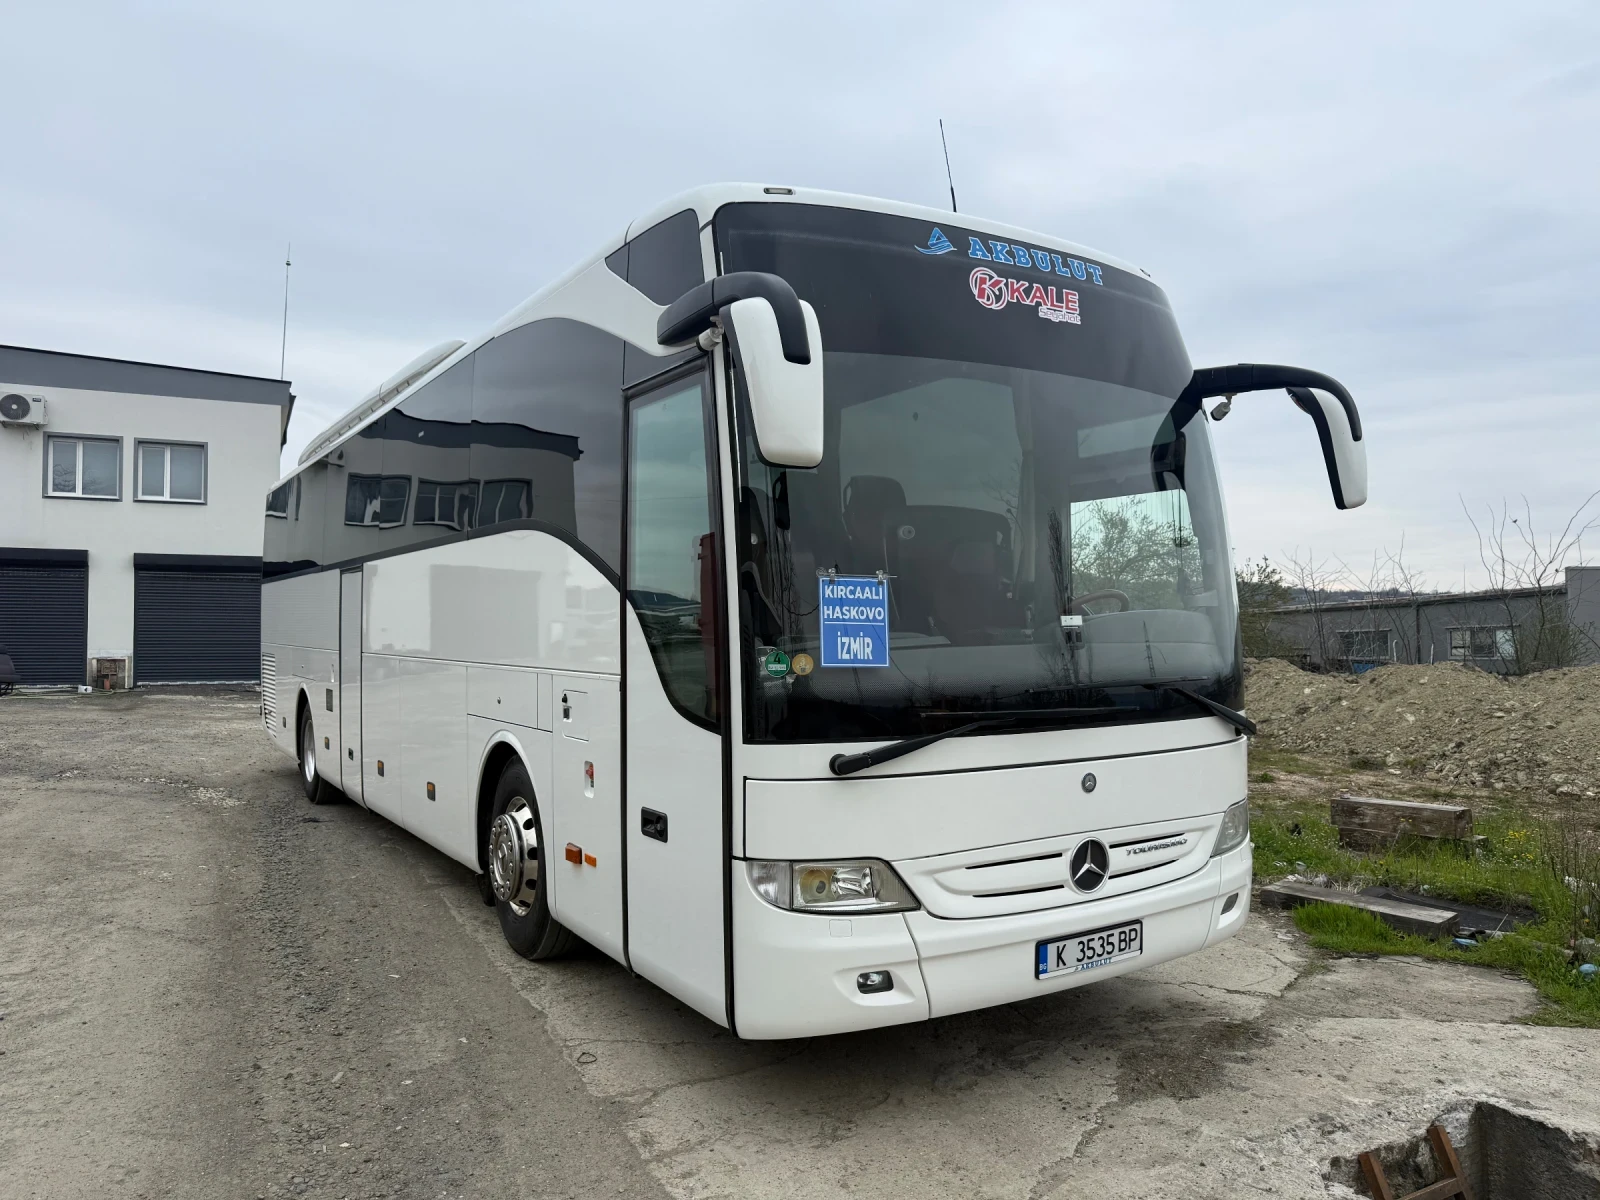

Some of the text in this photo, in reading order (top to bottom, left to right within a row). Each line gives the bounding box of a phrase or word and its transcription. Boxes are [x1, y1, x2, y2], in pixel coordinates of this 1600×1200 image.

[968, 236, 1103, 286] AKBULUT
[1007, 279, 1079, 314] KALE
[1039, 306, 1081, 325] Seyahat
[823, 605, 885, 620] HASKOVO
[837, 631, 873, 660] İZMİR
[773, 652, 781, 664] 4
[1056, 927, 1138, 968] K 3535 BP
[1039, 962, 1047, 971] BG
[1080, 957, 1112, 970] AKBULUT
